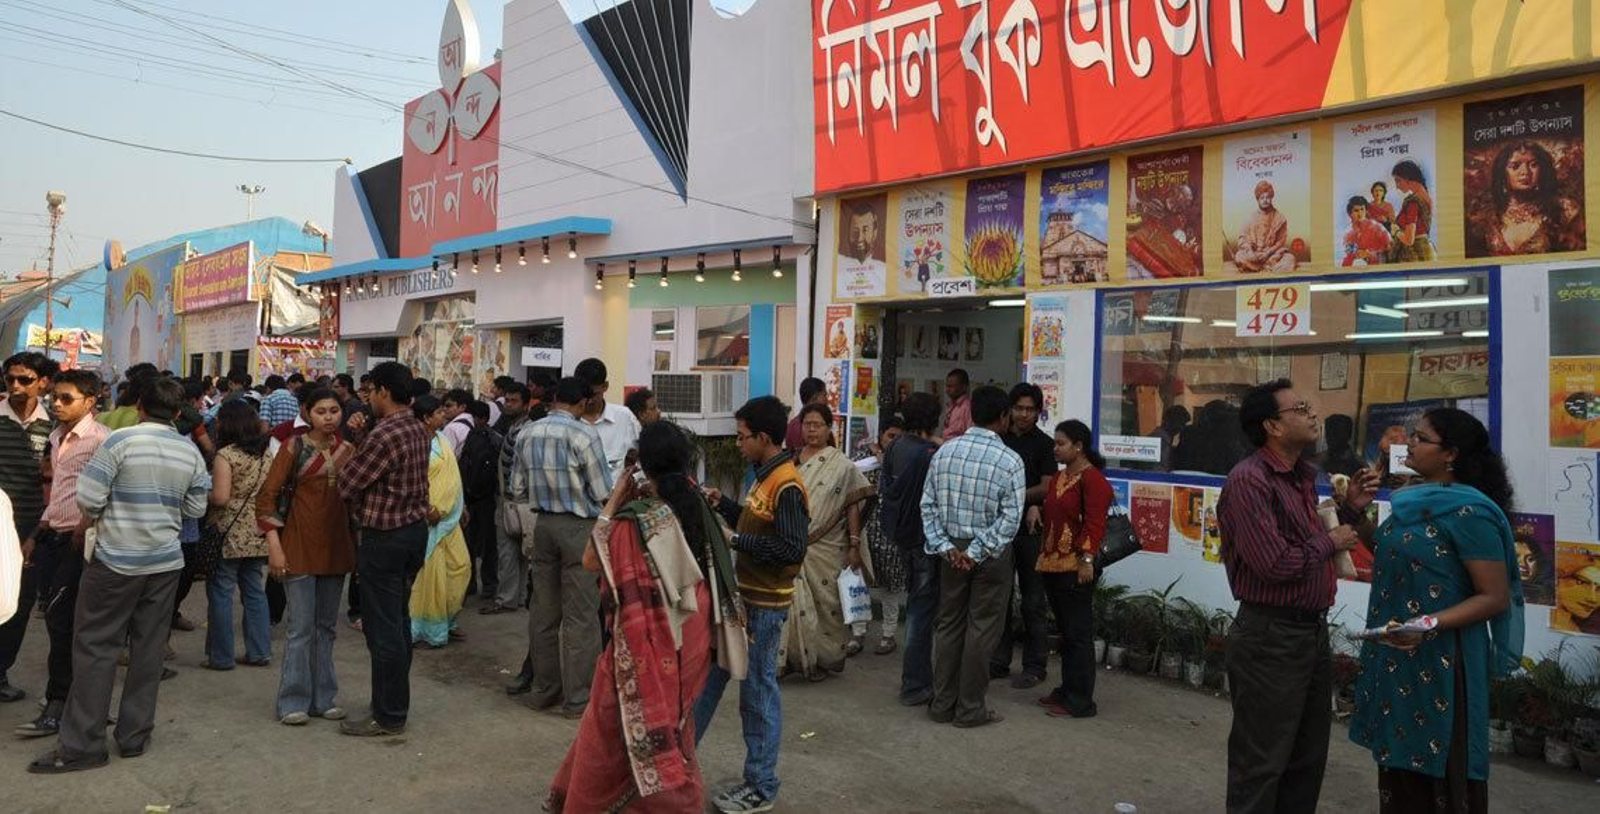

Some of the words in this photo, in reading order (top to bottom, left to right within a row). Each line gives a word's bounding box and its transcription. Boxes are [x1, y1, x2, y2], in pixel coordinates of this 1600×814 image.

[441, 37, 462, 69] আ
[956, 0, 1043, 157] বুক
[1350, 123, 1372, 137] সুনীল
[1474, 128, 1498, 142] সেরা
[1499, 119, 1527, 137] দশটি
[1529, 116, 1573, 133] উপন্যাস
[1236, 153, 1294, 172] বিবেকানন্দ
[1360, 146, 1385, 159] প্রিয়
[905, 223, 943, 238] উপন্যাস
[389, 268, 455, 297] PUBLISHERS
[931, 279, 973, 294] প্রবেশ
[1247, 287, 1299, 313] 479
[1247, 312, 1299, 337] 479
